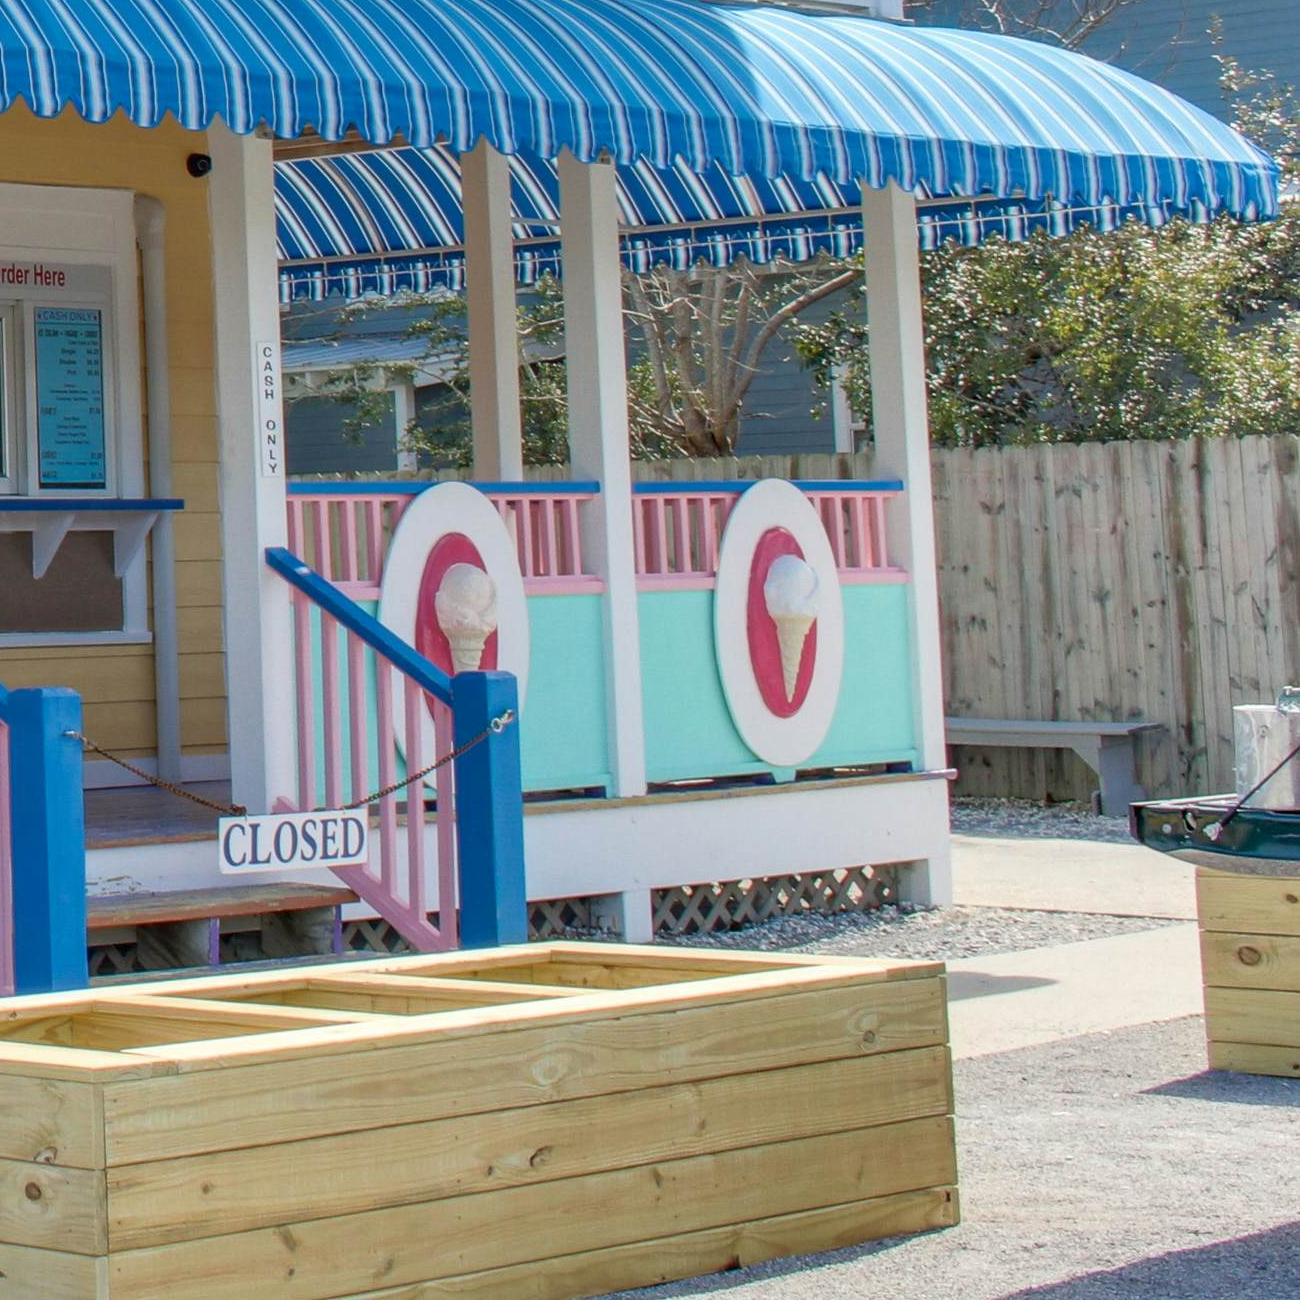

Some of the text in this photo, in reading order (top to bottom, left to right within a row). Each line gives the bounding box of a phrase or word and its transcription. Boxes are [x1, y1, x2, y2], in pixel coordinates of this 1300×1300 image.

[34, 264, 65, 286] Here
[263, 346, 277, 473] CASH ONLY
[223, 816, 365, 867] CLOSED
